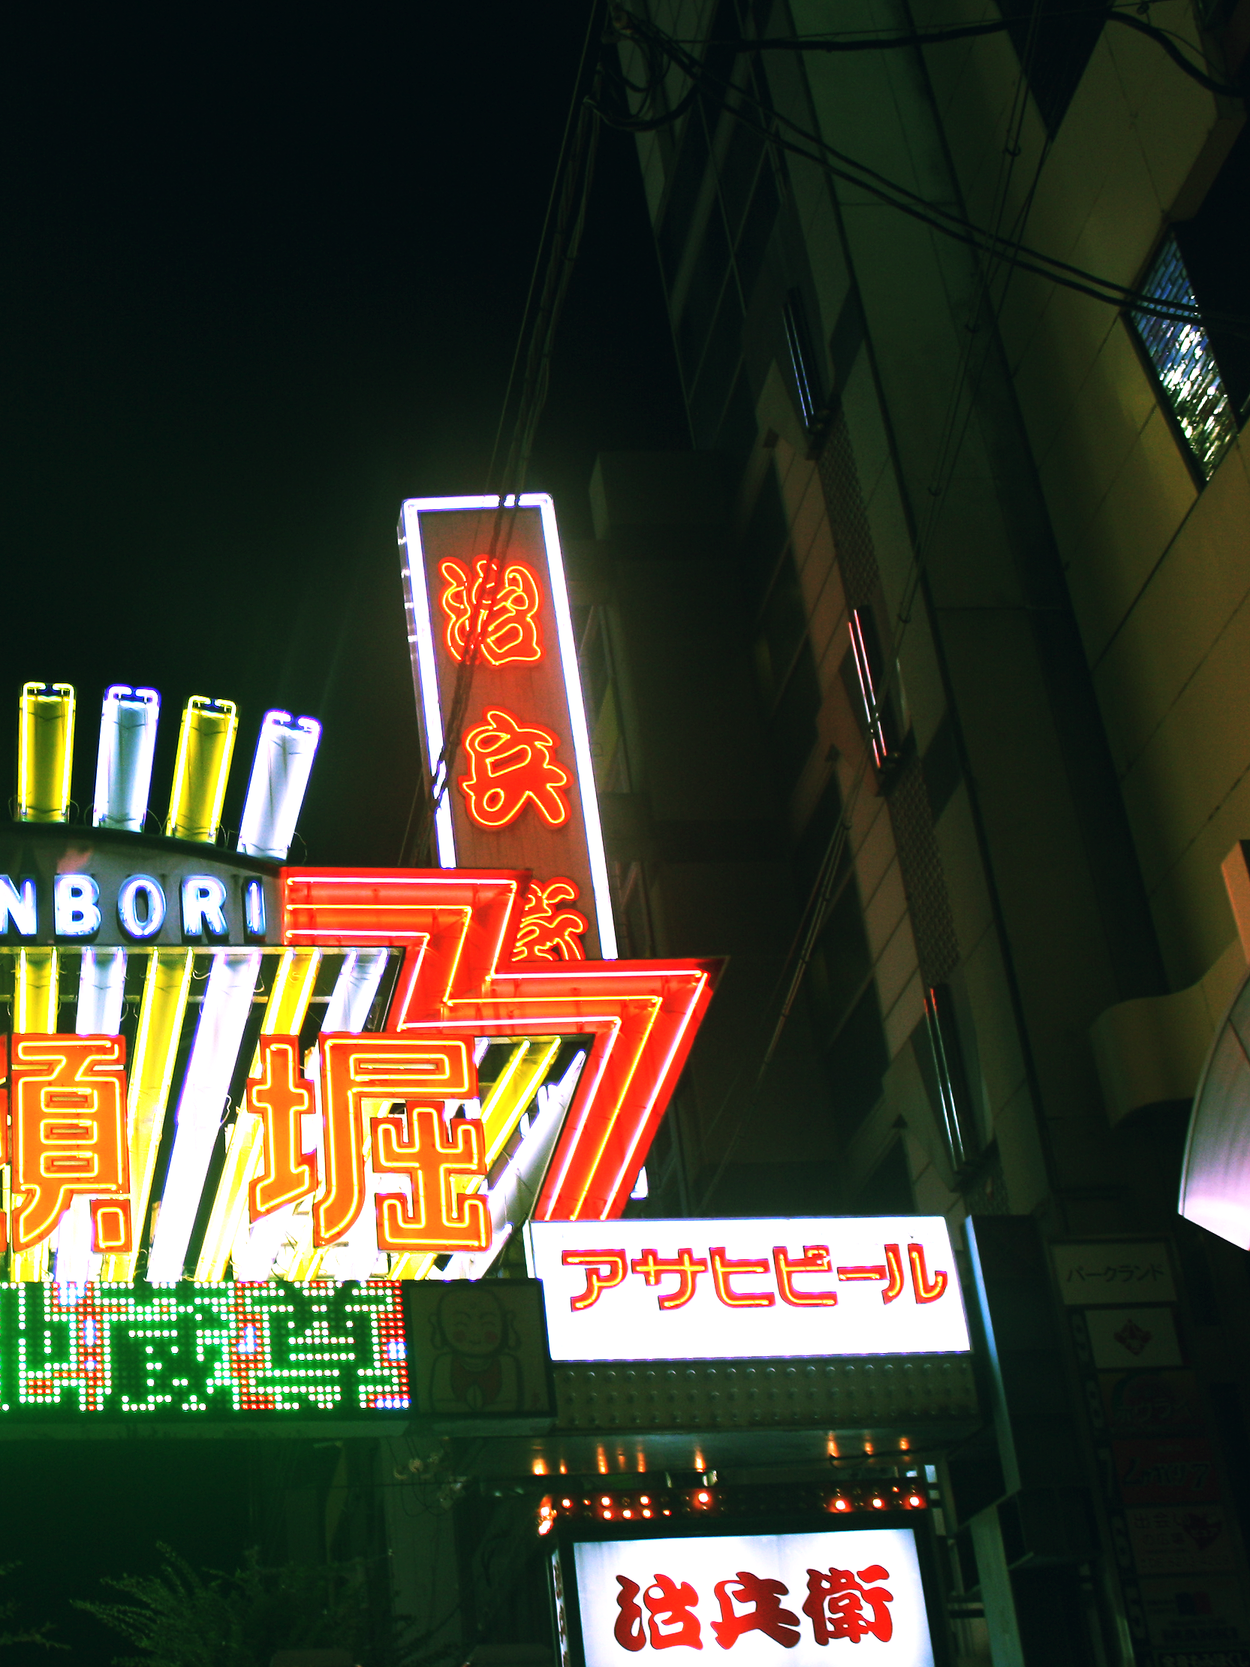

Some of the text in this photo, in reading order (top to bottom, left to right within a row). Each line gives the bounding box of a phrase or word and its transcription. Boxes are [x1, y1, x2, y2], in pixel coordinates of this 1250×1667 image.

[561, 1243, 949, 1312] アサヒビール
[1066, 1263, 1164, 1283] パークランド
[613, 1564, 895, 1652] 治兵衛
